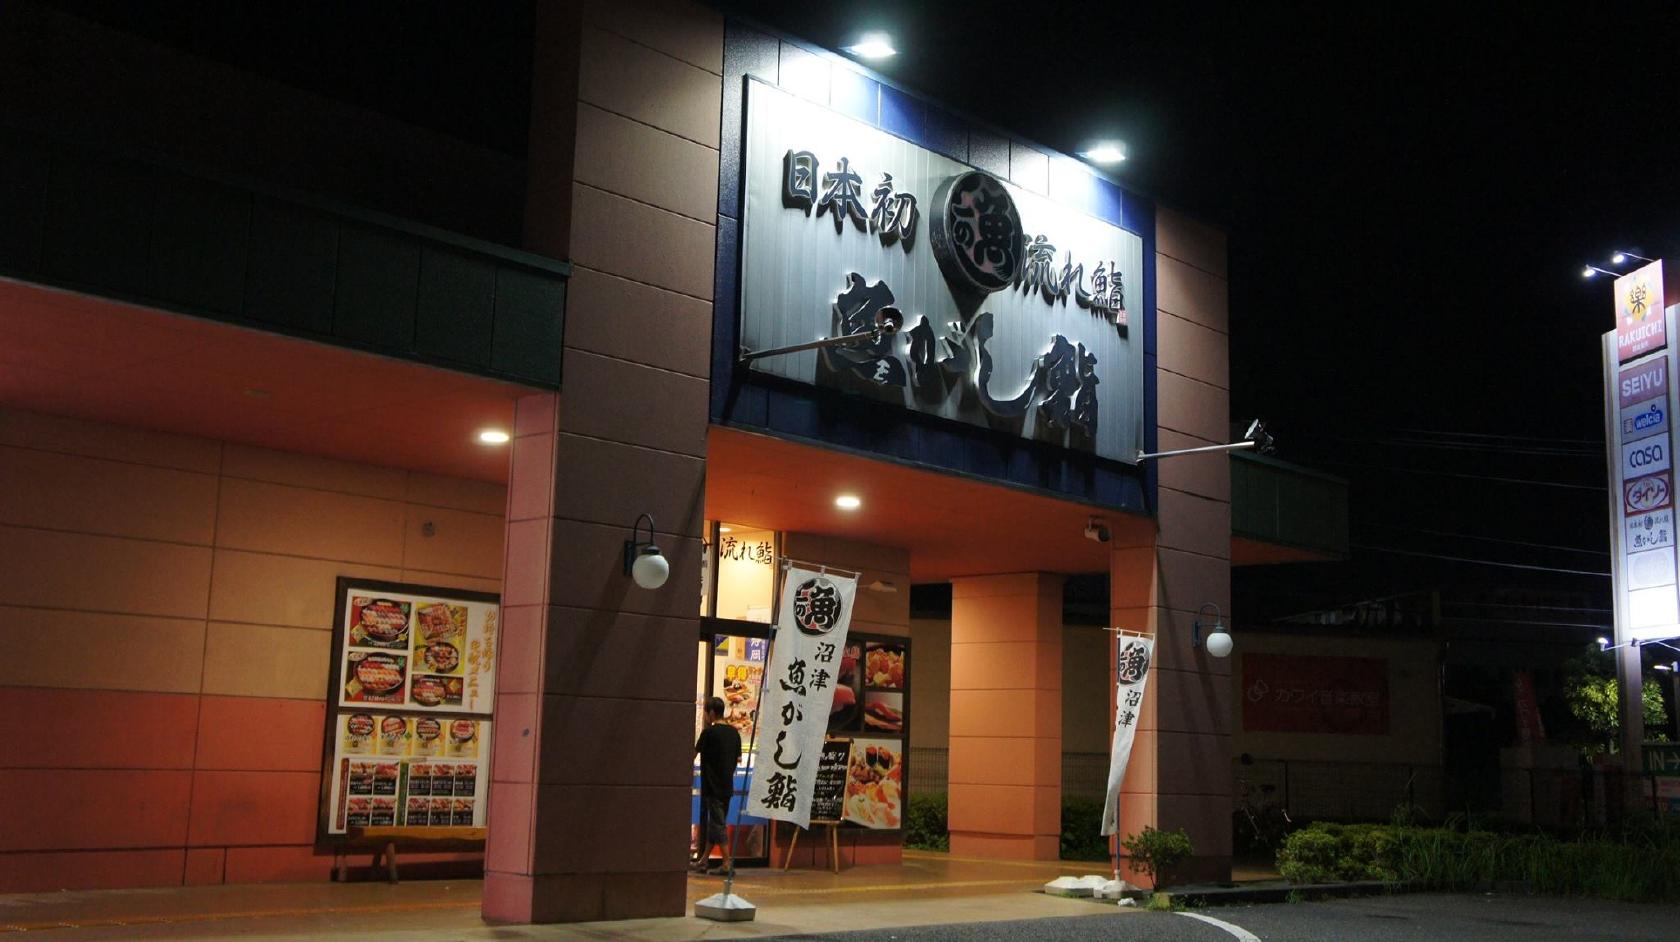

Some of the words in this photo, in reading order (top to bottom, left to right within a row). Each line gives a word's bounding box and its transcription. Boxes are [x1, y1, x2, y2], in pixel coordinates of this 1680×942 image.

[783, 149, 919, 251] 日本初
[1017, 233, 1126, 313] 流れ鮨
[1618, 319, 1663, 348] RAKUICHI
[818, 272, 1100, 434] 魚がし鮨
[1622, 367, 1663, 397] SEIYU
[1635, 406, 1662, 430] welcia
[1629, 444, 1663, 469] casa
[1633, 484, 1665, 505] ダイソー
[719, 537, 773, 565] 流れ鮨
[809, 641, 836, 692] 沼津
[1118, 689, 1141, 727] 沼津
[761, 657, 806, 812] 魚がし鮨
[1649, 751, 1665, 770] IN
